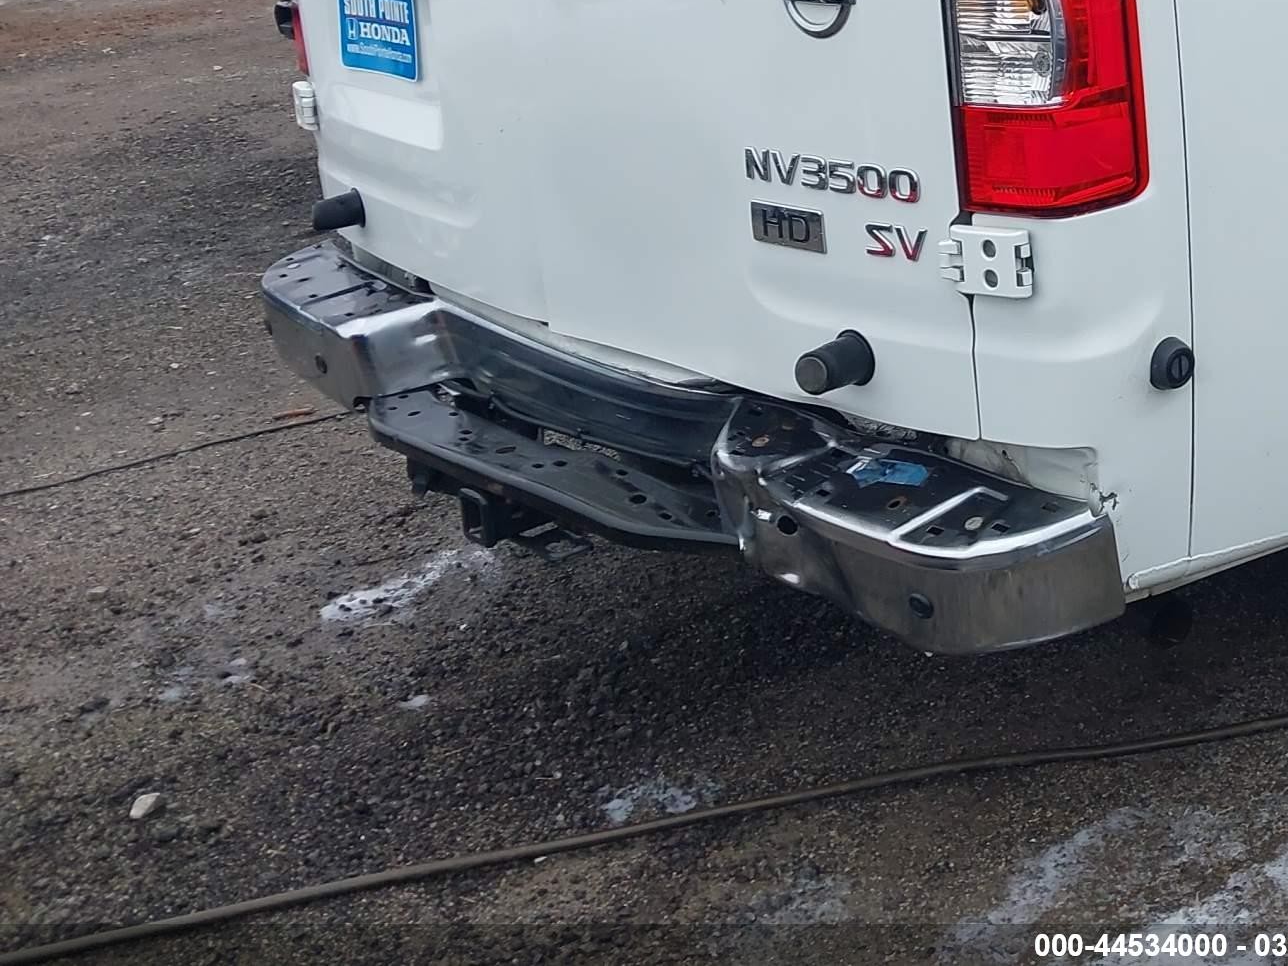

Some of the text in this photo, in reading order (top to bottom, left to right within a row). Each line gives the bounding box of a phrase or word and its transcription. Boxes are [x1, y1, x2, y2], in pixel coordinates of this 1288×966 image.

[359, 21, 411, 46] HONDA
[744, 146, 921, 203] NV3500
[761, 208, 810, 244] HD
[864, 221, 928, 262] SV
